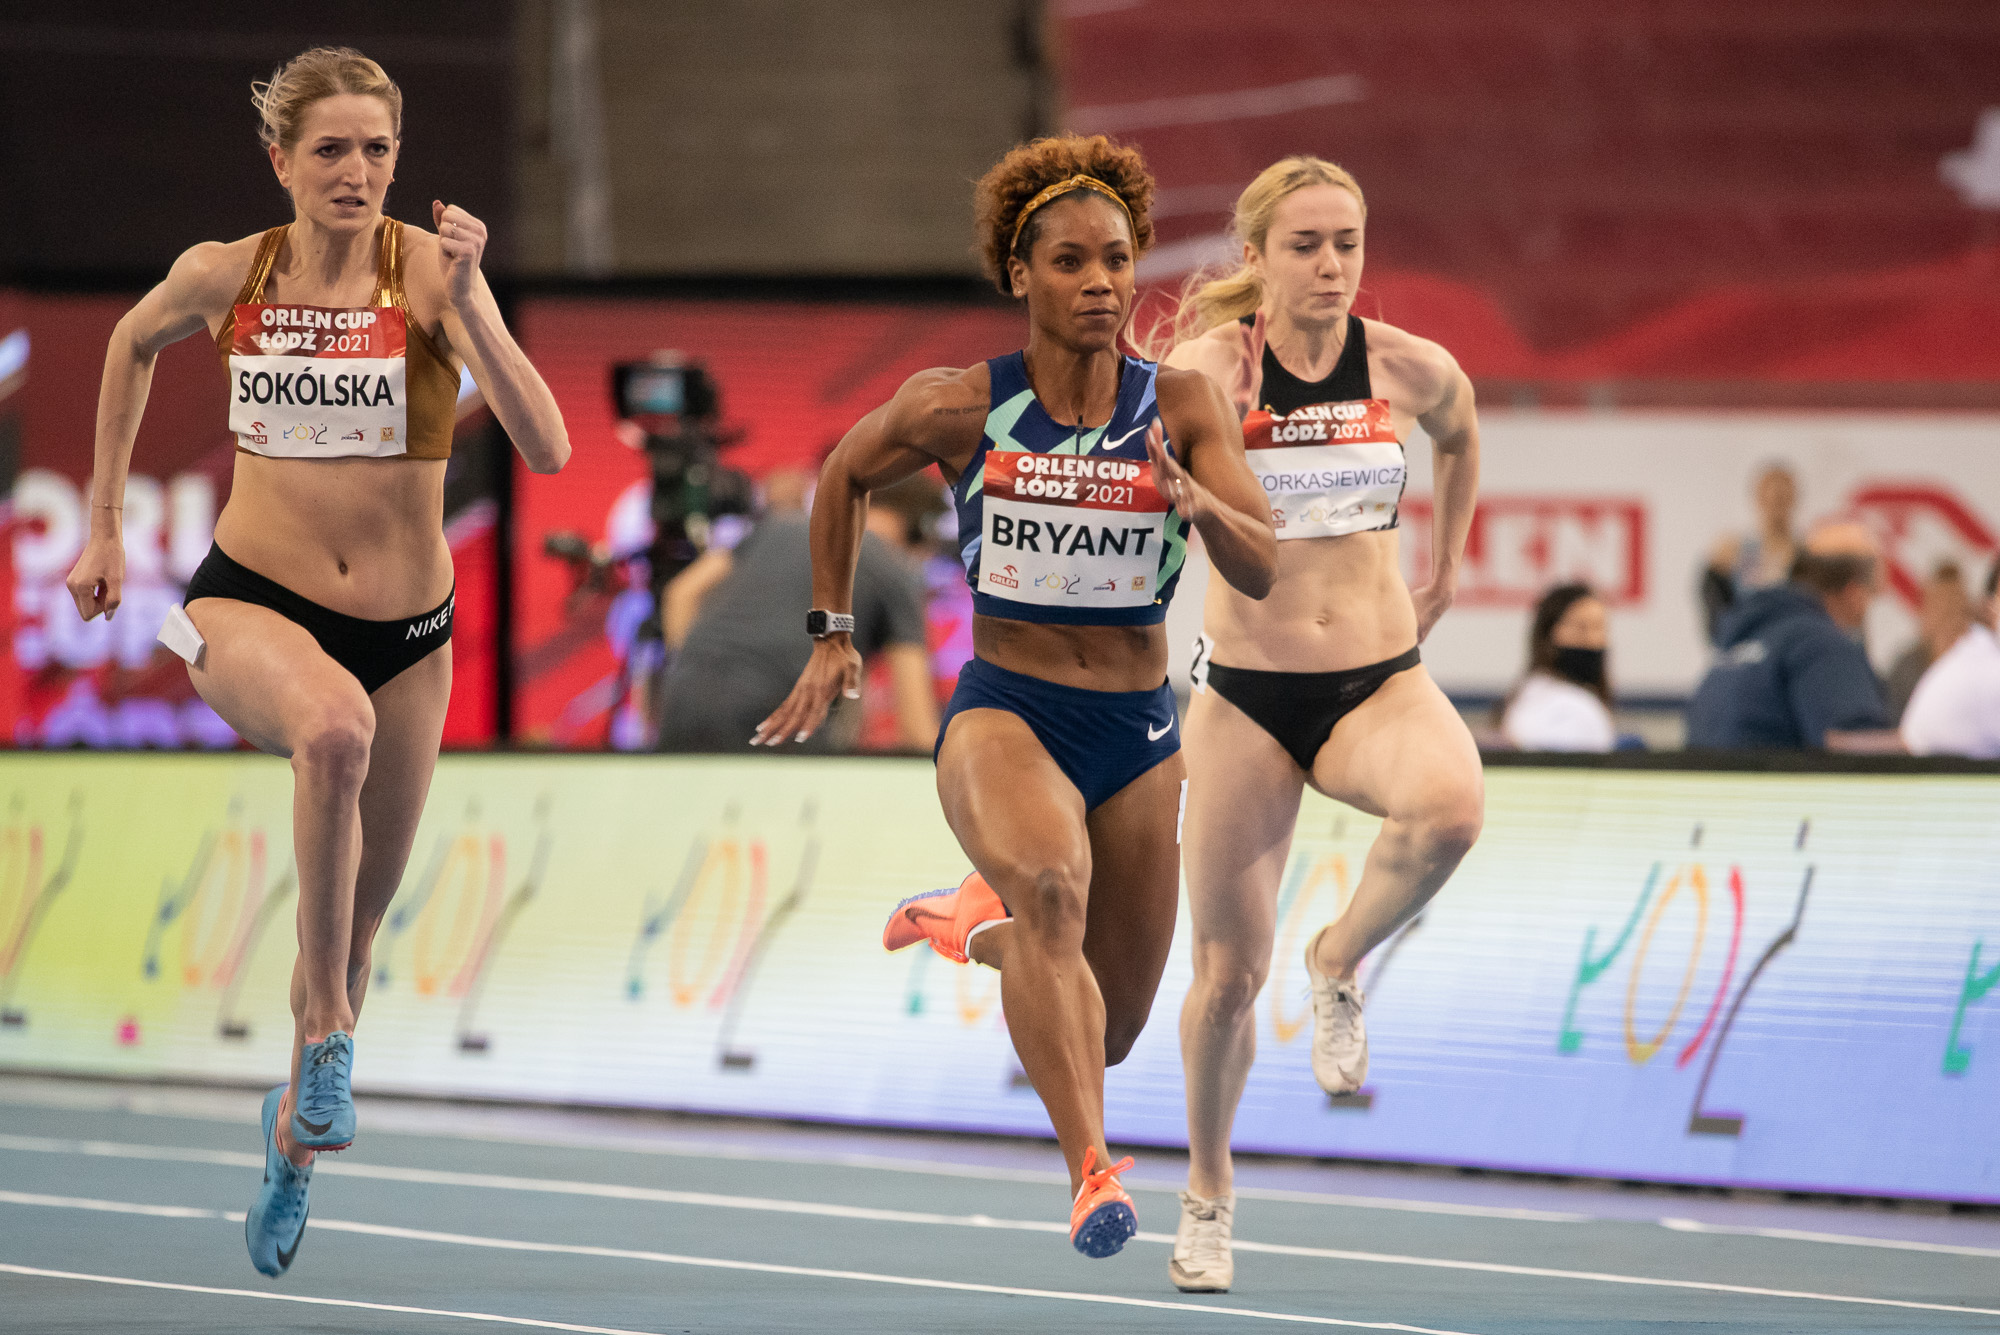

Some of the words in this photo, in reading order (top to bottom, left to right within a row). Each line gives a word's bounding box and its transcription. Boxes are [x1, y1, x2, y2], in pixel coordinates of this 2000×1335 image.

[261, 308, 331, 329] ORLEN
[335, 311, 377, 329] CUP
[260, 327, 317, 350] ŁÓDŹ
[324, 334, 370, 352] 2021
[238, 367, 394, 407] SOKÓLSKA
[1332, 404, 1368, 420] CUP
[1271, 420, 1328, 443] ŁÓDŹ
[1331, 422, 1371, 439] 2021
[1016, 456, 1094, 478] ORLEN
[1097, 461, 1140, 482] CUP
[1257, 467, 1401, 491] ORKASIEWICZ
[1014, 475, 1079, 500] ŁÓDŹ
[1085, 484, 1134, 505] 2021
[992, 513, 1154, 556] BRYANT
[405, 606, 448, 640] NIKE
